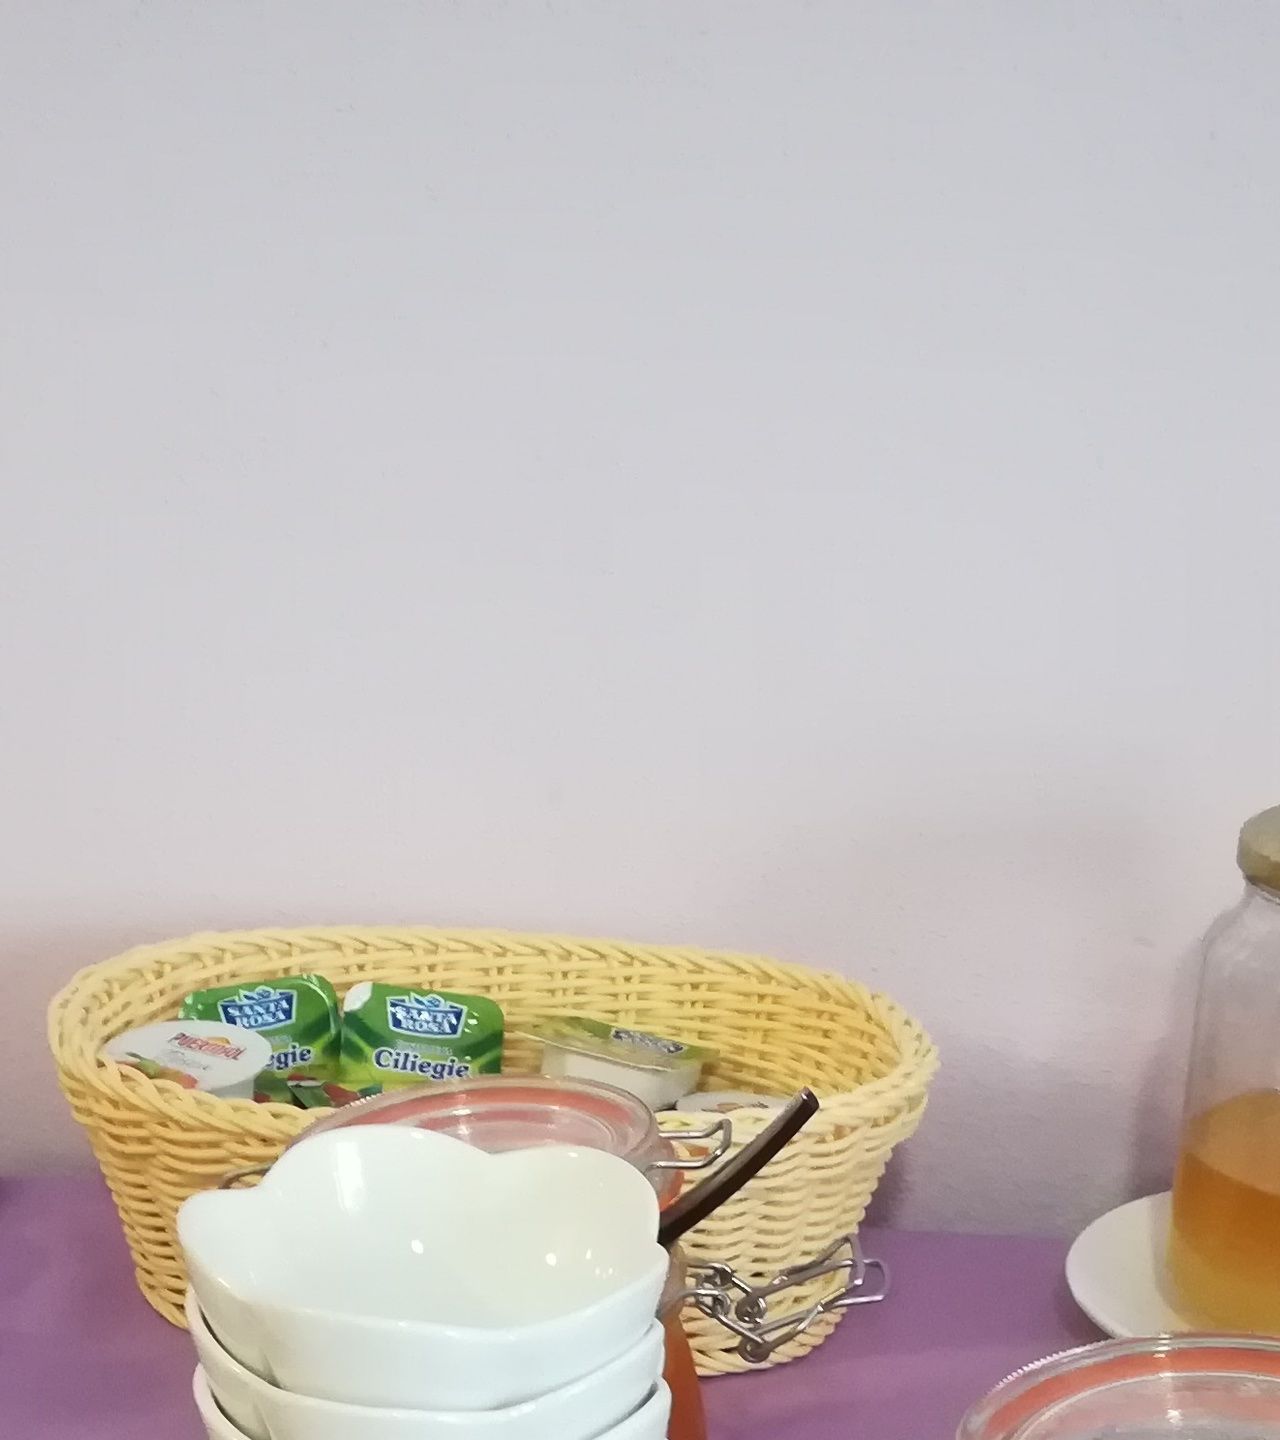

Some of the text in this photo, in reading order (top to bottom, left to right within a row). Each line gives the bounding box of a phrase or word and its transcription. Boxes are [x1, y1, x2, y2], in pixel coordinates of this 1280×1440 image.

[228, 998, 290, 1018] SANTA
[395, 1006, 458, 1026] SANTA
[235, 1010, 287, 1028] ROSA
[401, 1018, 453, 1034] ROSA
[374, 1048, 470, 1080] Ciliegie
